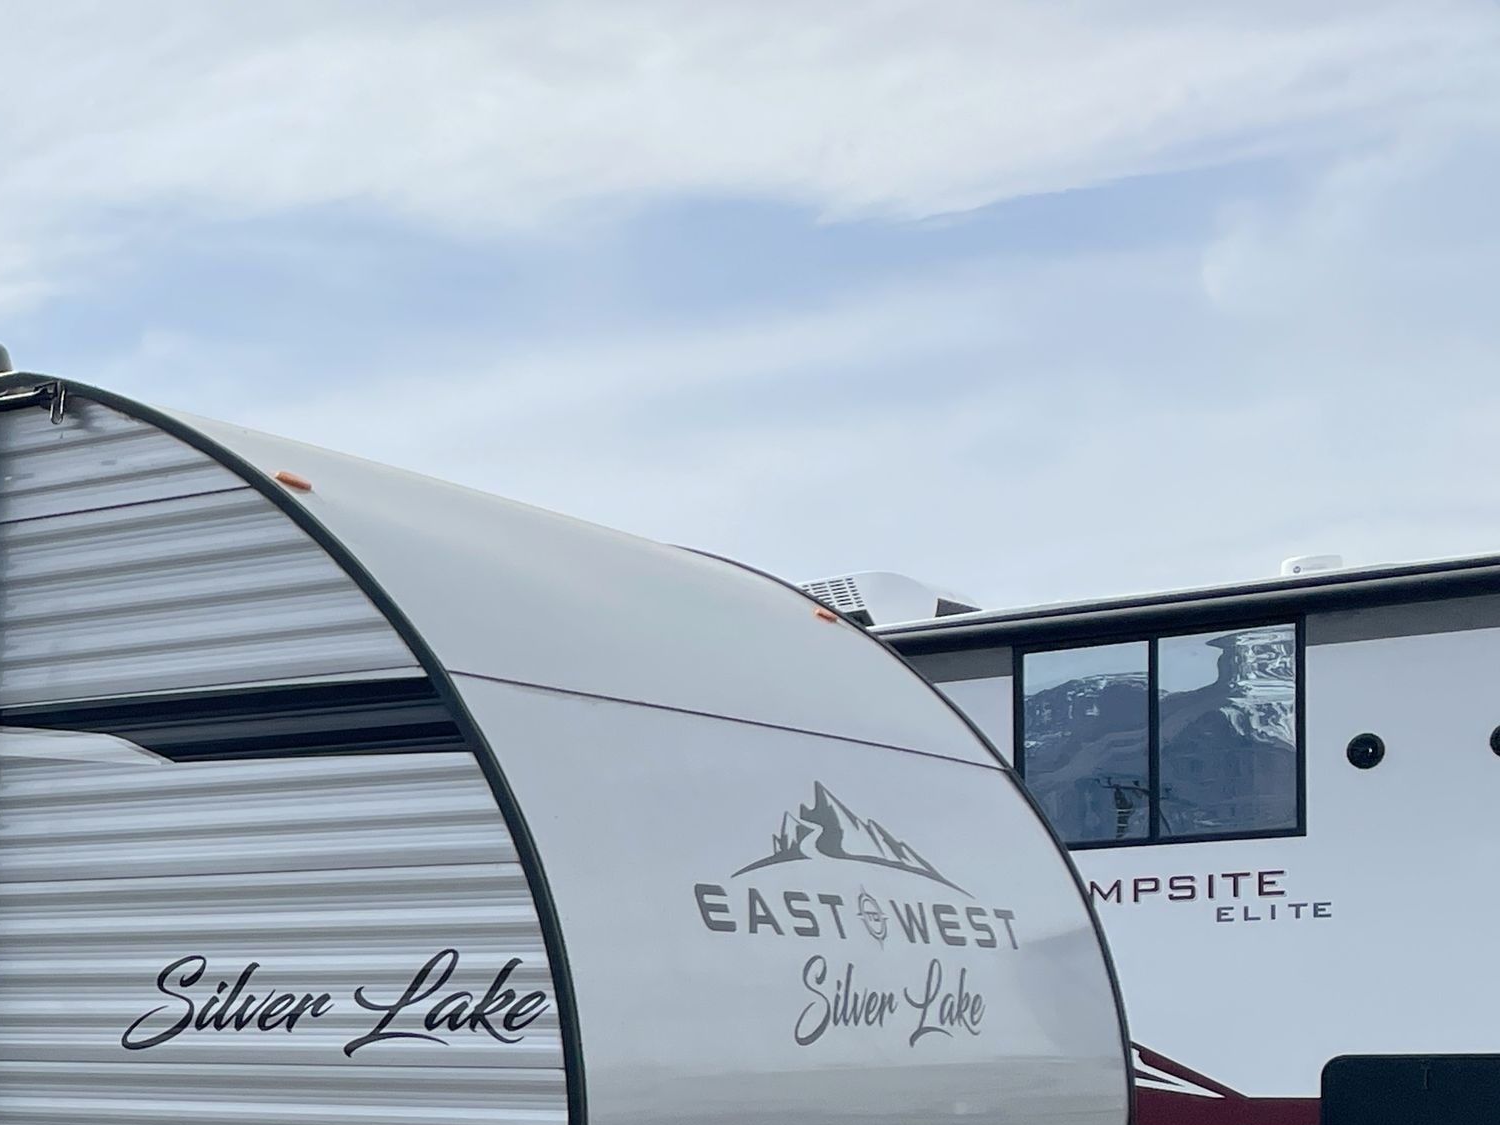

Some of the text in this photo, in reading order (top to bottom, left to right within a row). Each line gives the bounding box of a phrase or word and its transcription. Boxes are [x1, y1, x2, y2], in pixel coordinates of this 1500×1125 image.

[694, 883, 847, 940] EAST
[889, 899, 1019, 950] WEST
[1216, 902, 1332, 922] ELITE
[121, 948, 550, 1058] Silver Lake
[794, 955, 986, 1048] Silver Lake
